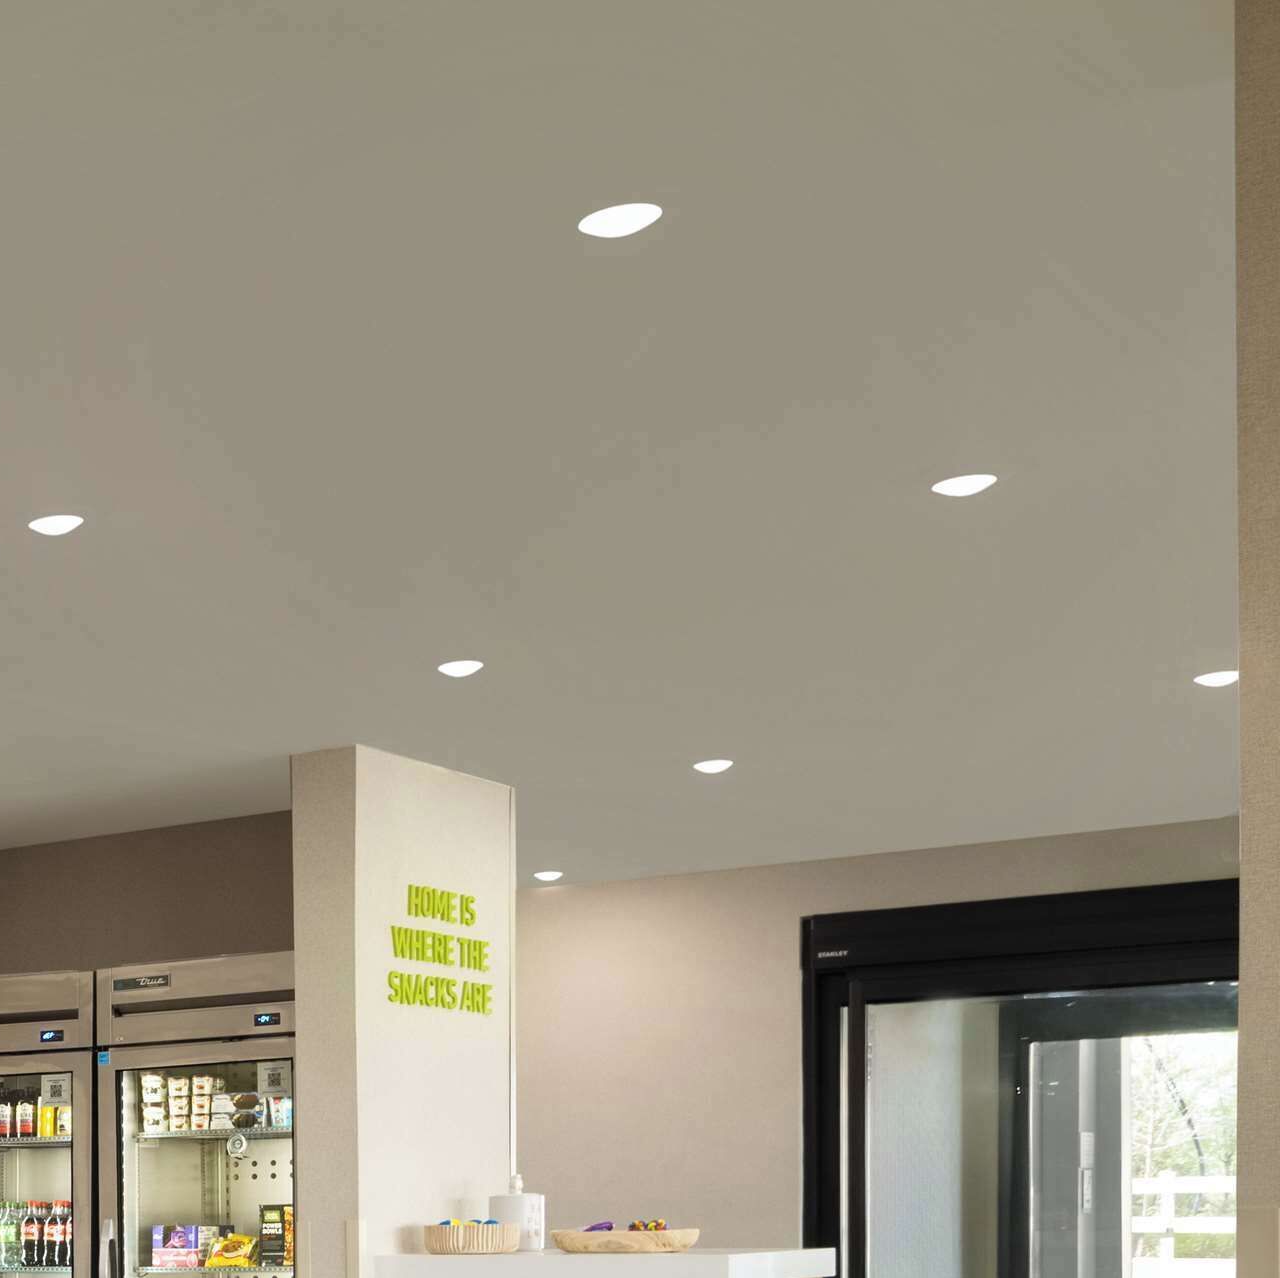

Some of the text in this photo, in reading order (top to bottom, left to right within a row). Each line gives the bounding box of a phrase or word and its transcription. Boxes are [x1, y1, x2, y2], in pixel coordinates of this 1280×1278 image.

[407, 884, 477, 926] HOME IS
[391, 925, 490, 972] WHERE THE
[388, 971, 493, 1016] SNACKS ARE
